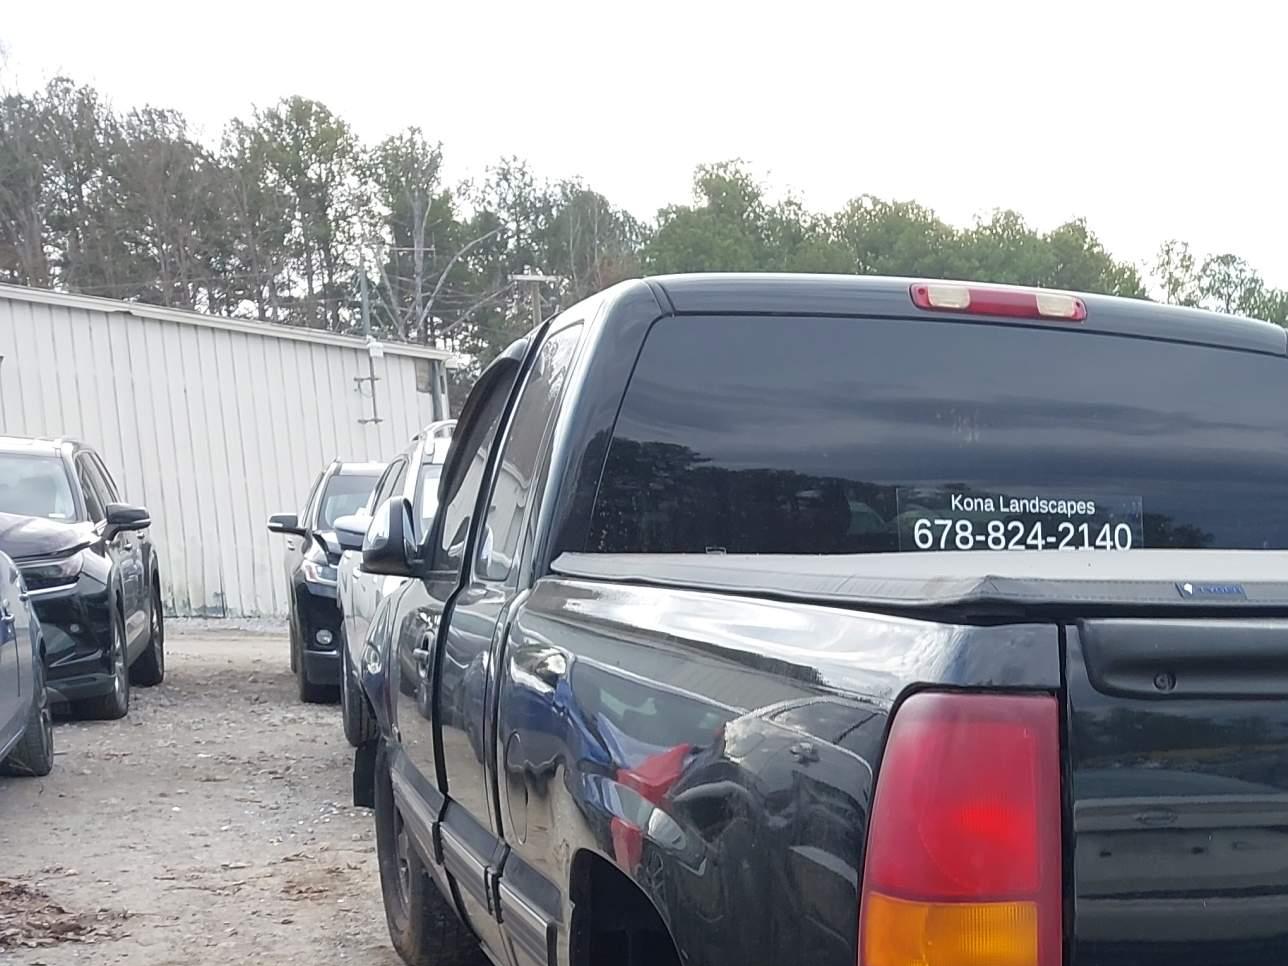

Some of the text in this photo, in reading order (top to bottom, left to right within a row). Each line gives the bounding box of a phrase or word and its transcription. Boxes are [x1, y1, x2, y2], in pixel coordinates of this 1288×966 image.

[951, 493, 1096, 517] Kona Landscapes
[913, 518, 1132, 551] 678-824-2140
